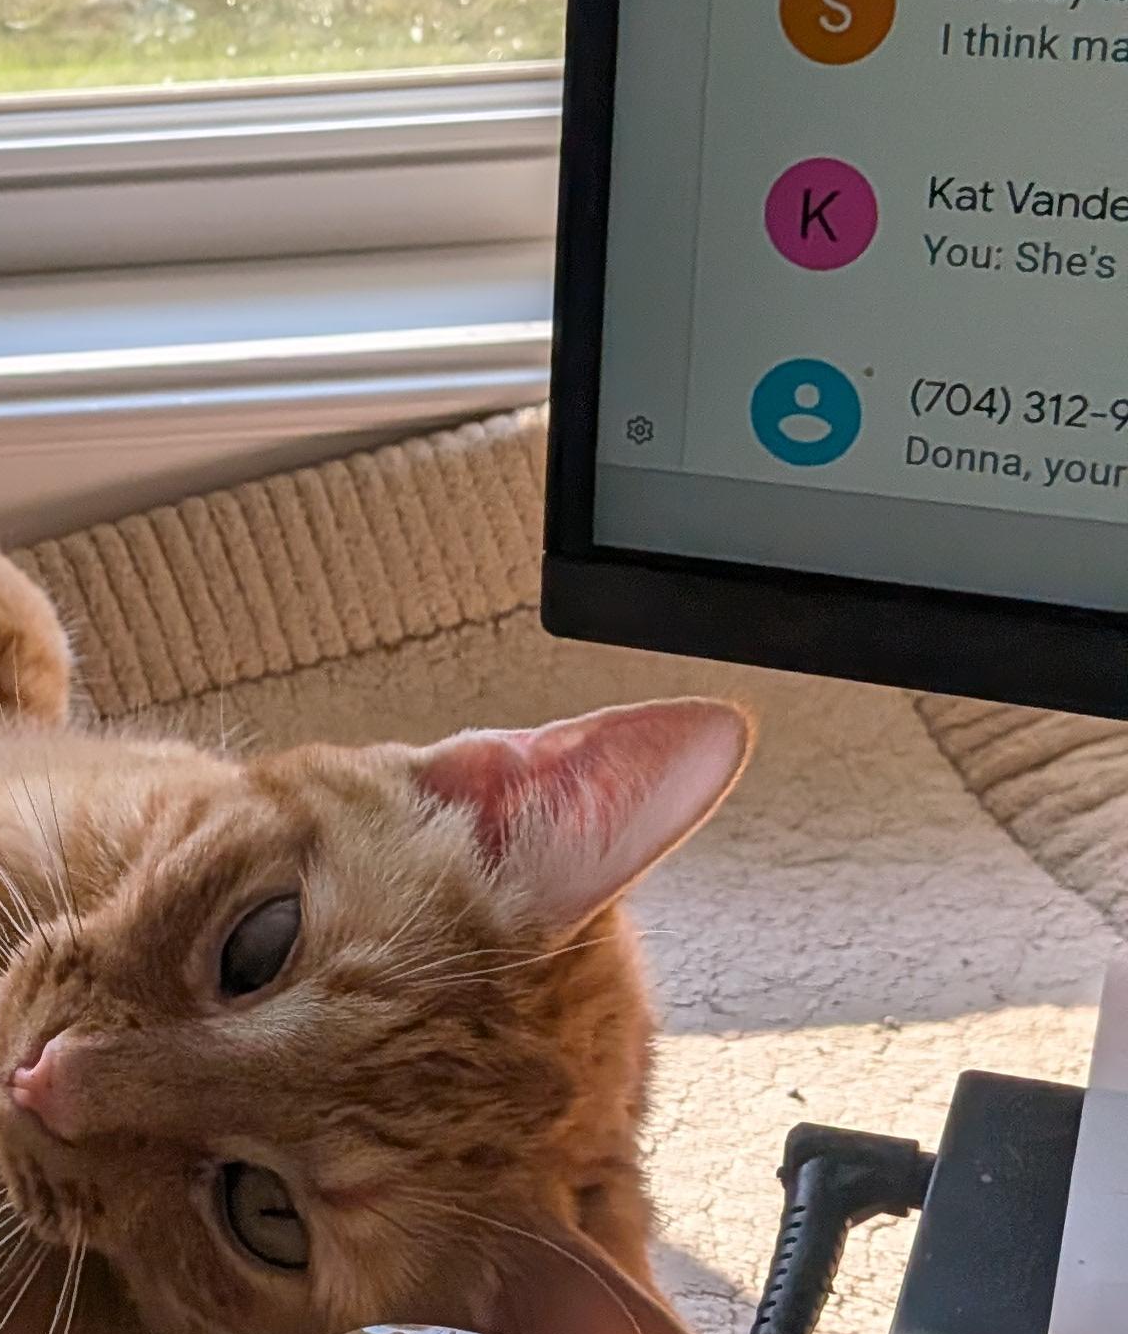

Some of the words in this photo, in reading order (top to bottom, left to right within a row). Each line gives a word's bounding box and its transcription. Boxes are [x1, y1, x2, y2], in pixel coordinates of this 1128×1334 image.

[941, 23, 951, 57] I
[963, 22, 1060, 61] think
[799, 187, 841, 243] K
[926, 174, 995, 214] Kat
[1005, 180, 1128, 223] Vande
[923, 233, 1003, 271] You:
[909, 377, 1012, 426] (704)
[1022, 389, 1128, 433] 312-9
[905, 434, 1033, 483] Donna,
[1043, 453, 1128, 488] your
